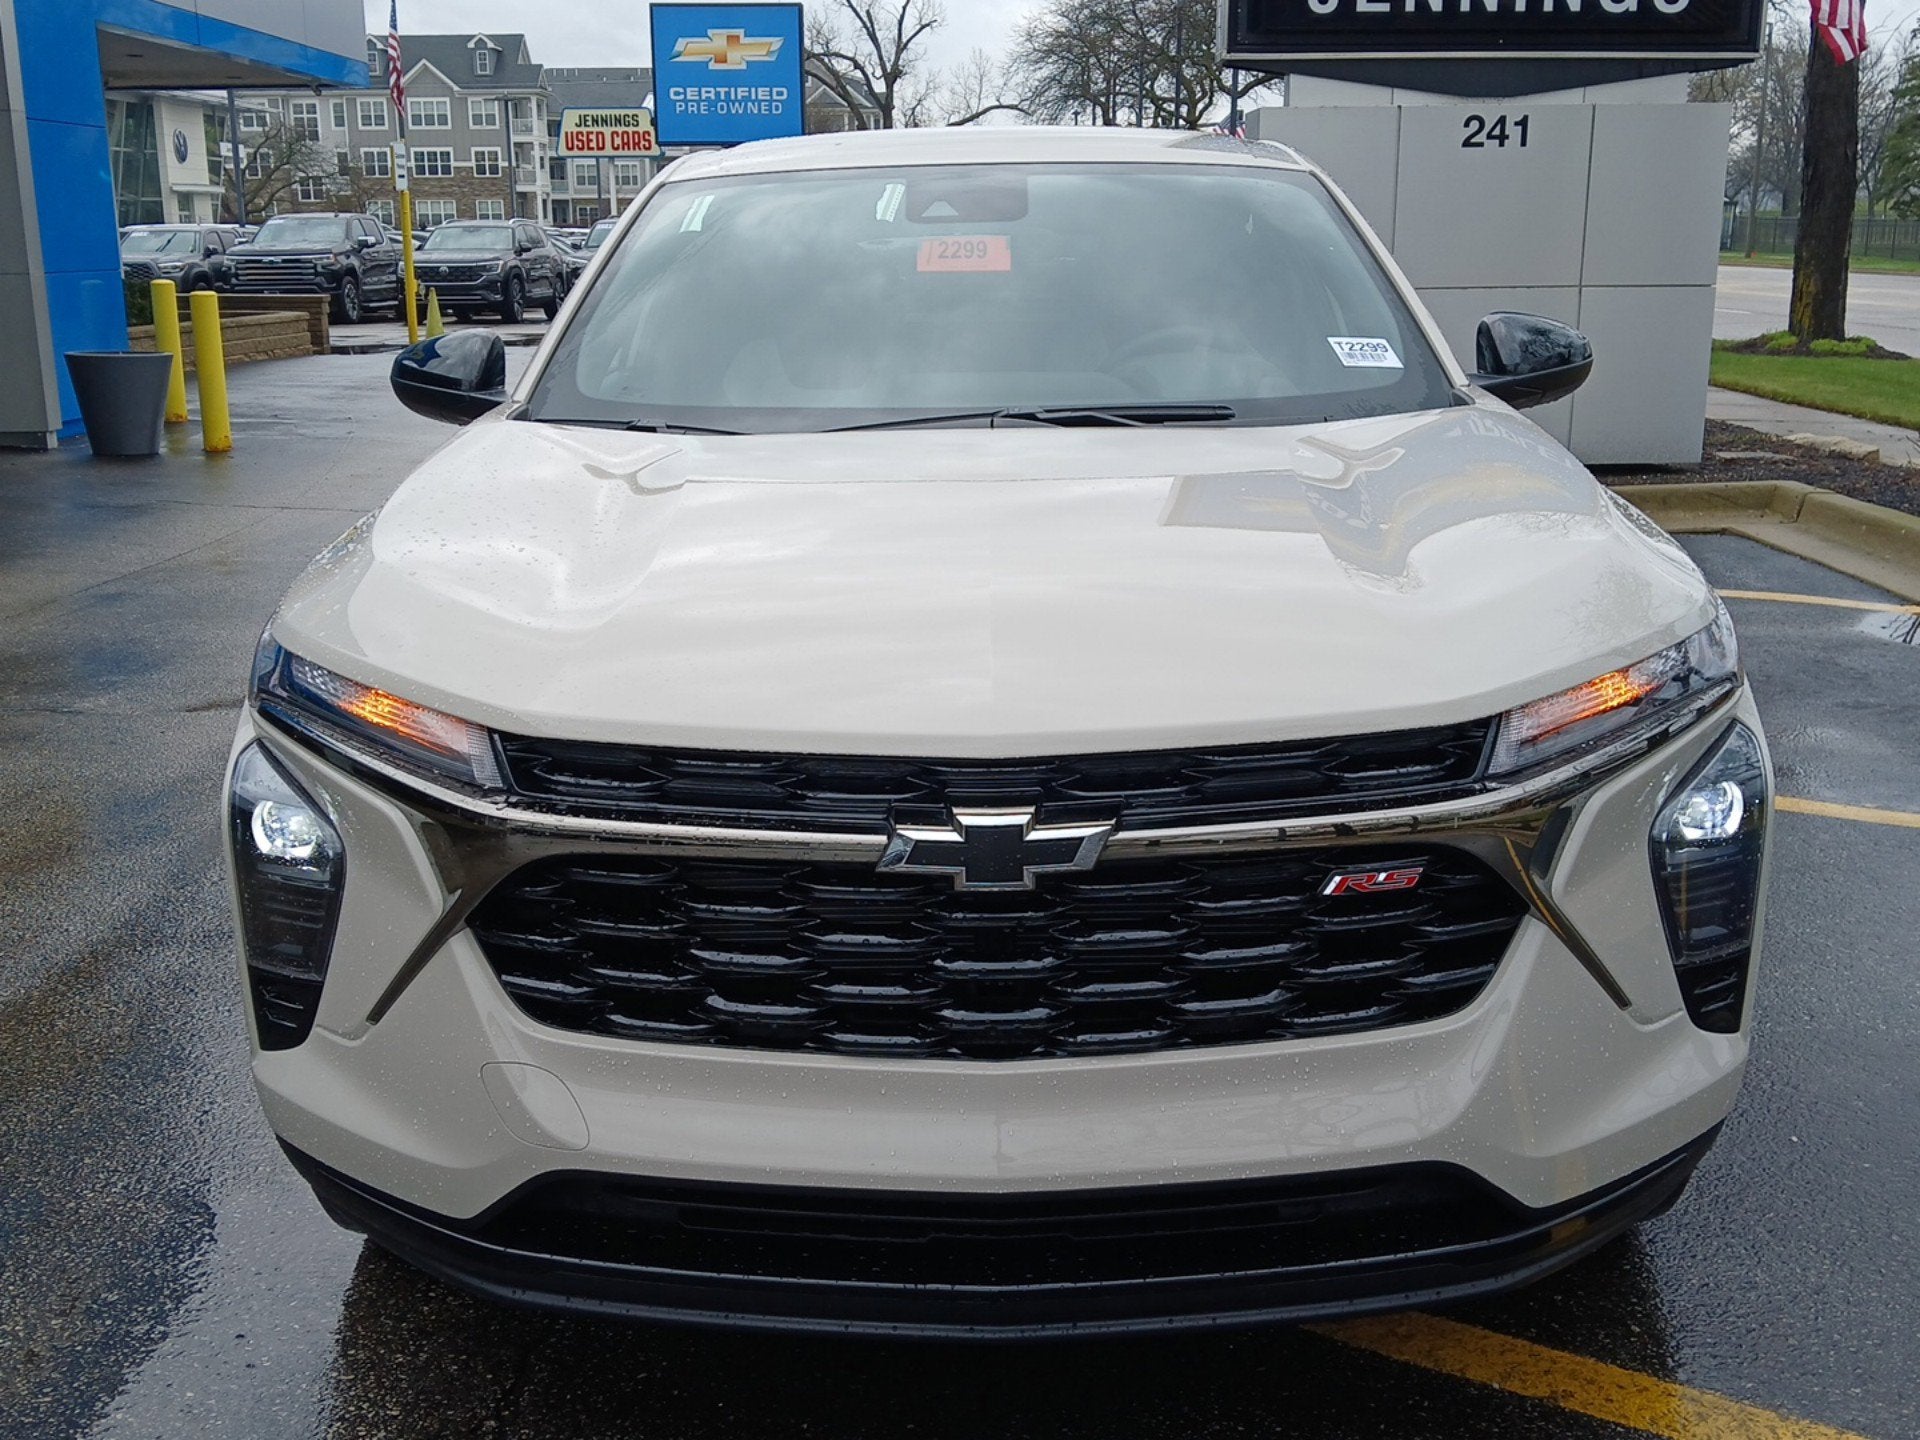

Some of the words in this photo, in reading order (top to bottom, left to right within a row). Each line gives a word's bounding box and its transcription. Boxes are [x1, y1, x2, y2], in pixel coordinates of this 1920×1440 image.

[669, 87, 788, 100] CERTIFIED
[675, 102, 782, 114] PRE-OWNED
[575, 113, 640, 127] JENNINGS
[1461, 114, 1529, 148] 241
[564, 131, 605, 151] USED
[610, 130, 652, 151] CARS
[1333, 341, 1389, 353] T2299
[1325, 868, 1423, 896] RS
